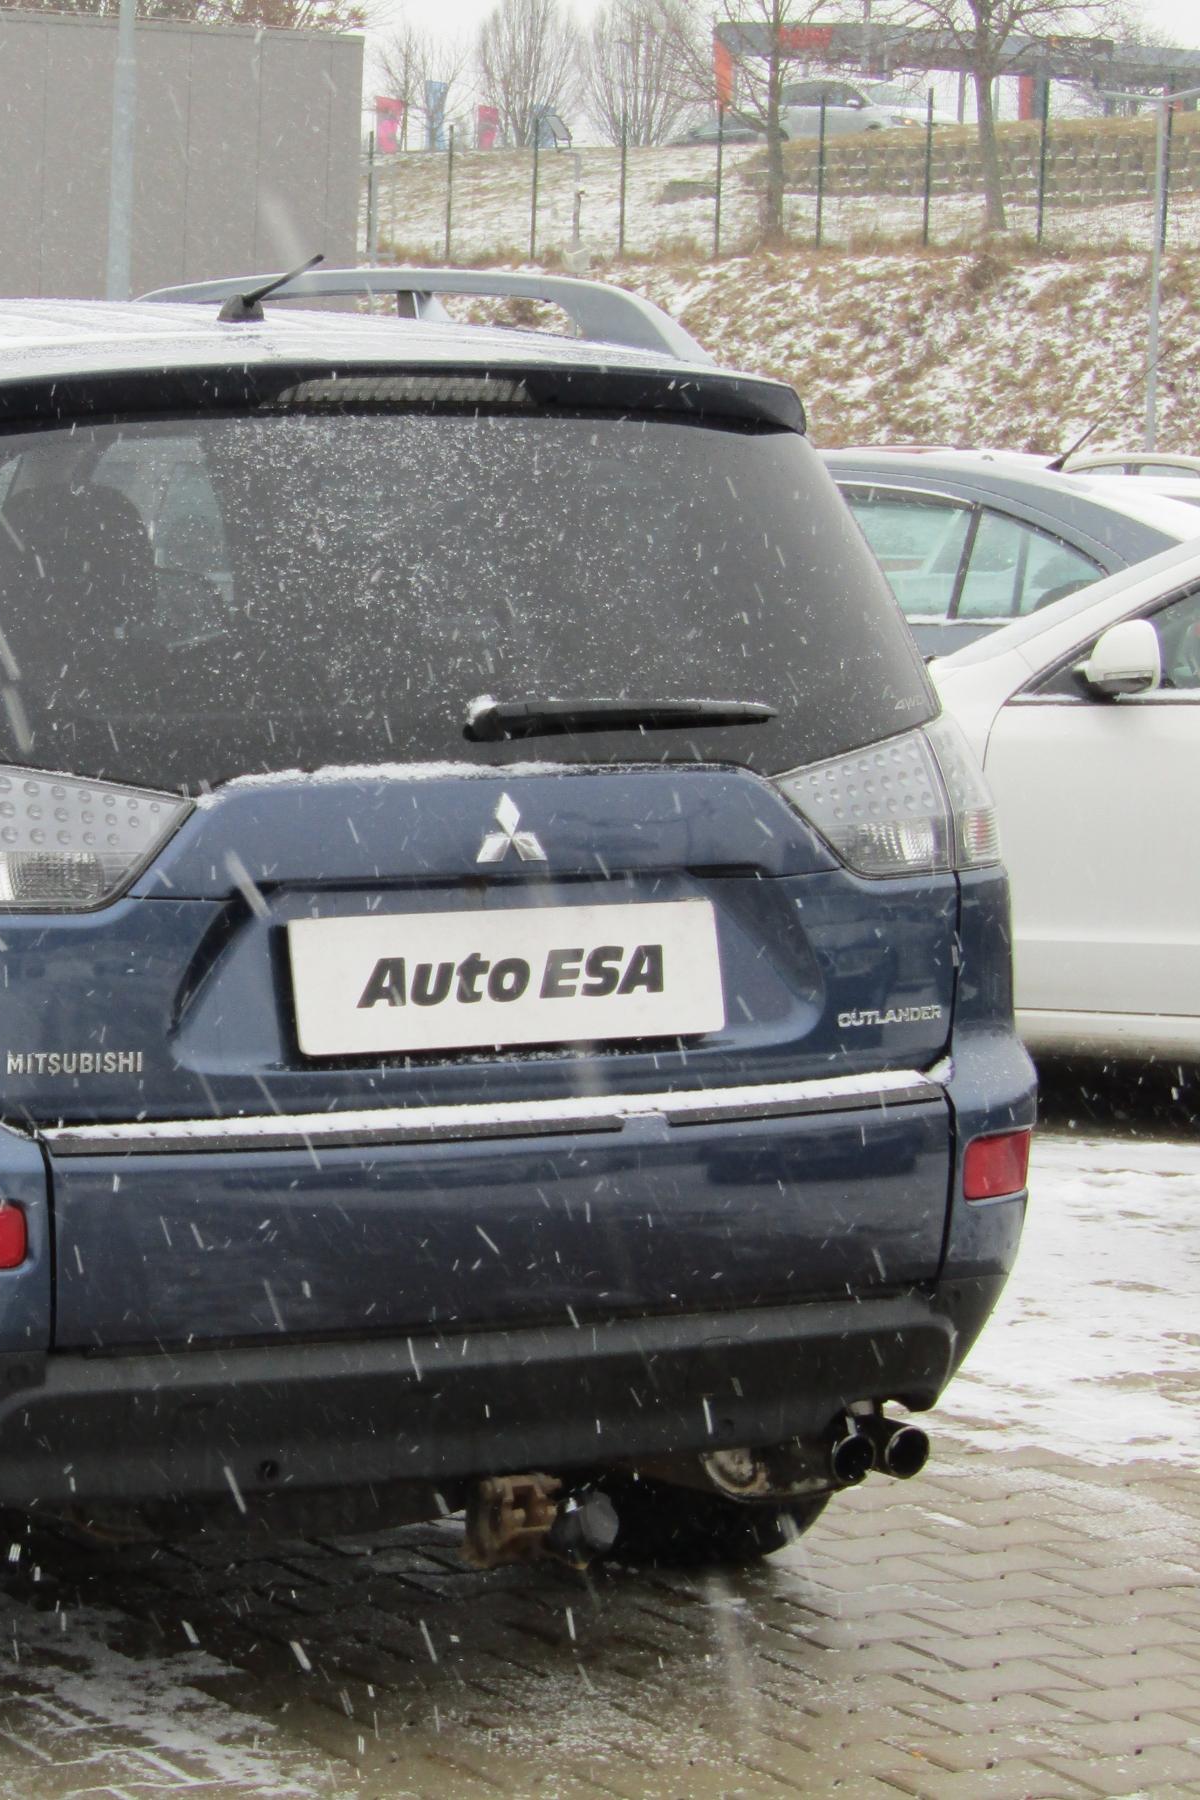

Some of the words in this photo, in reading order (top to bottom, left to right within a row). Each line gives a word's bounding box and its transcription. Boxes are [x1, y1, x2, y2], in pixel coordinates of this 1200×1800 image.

[356, 952, 530, 1009] Auto
[539, 944, 664, 999] ESA
[838, 1005, 941, 1028] OUTLANDER
[7, 1051, 142, 1075] MITSUBISHI
